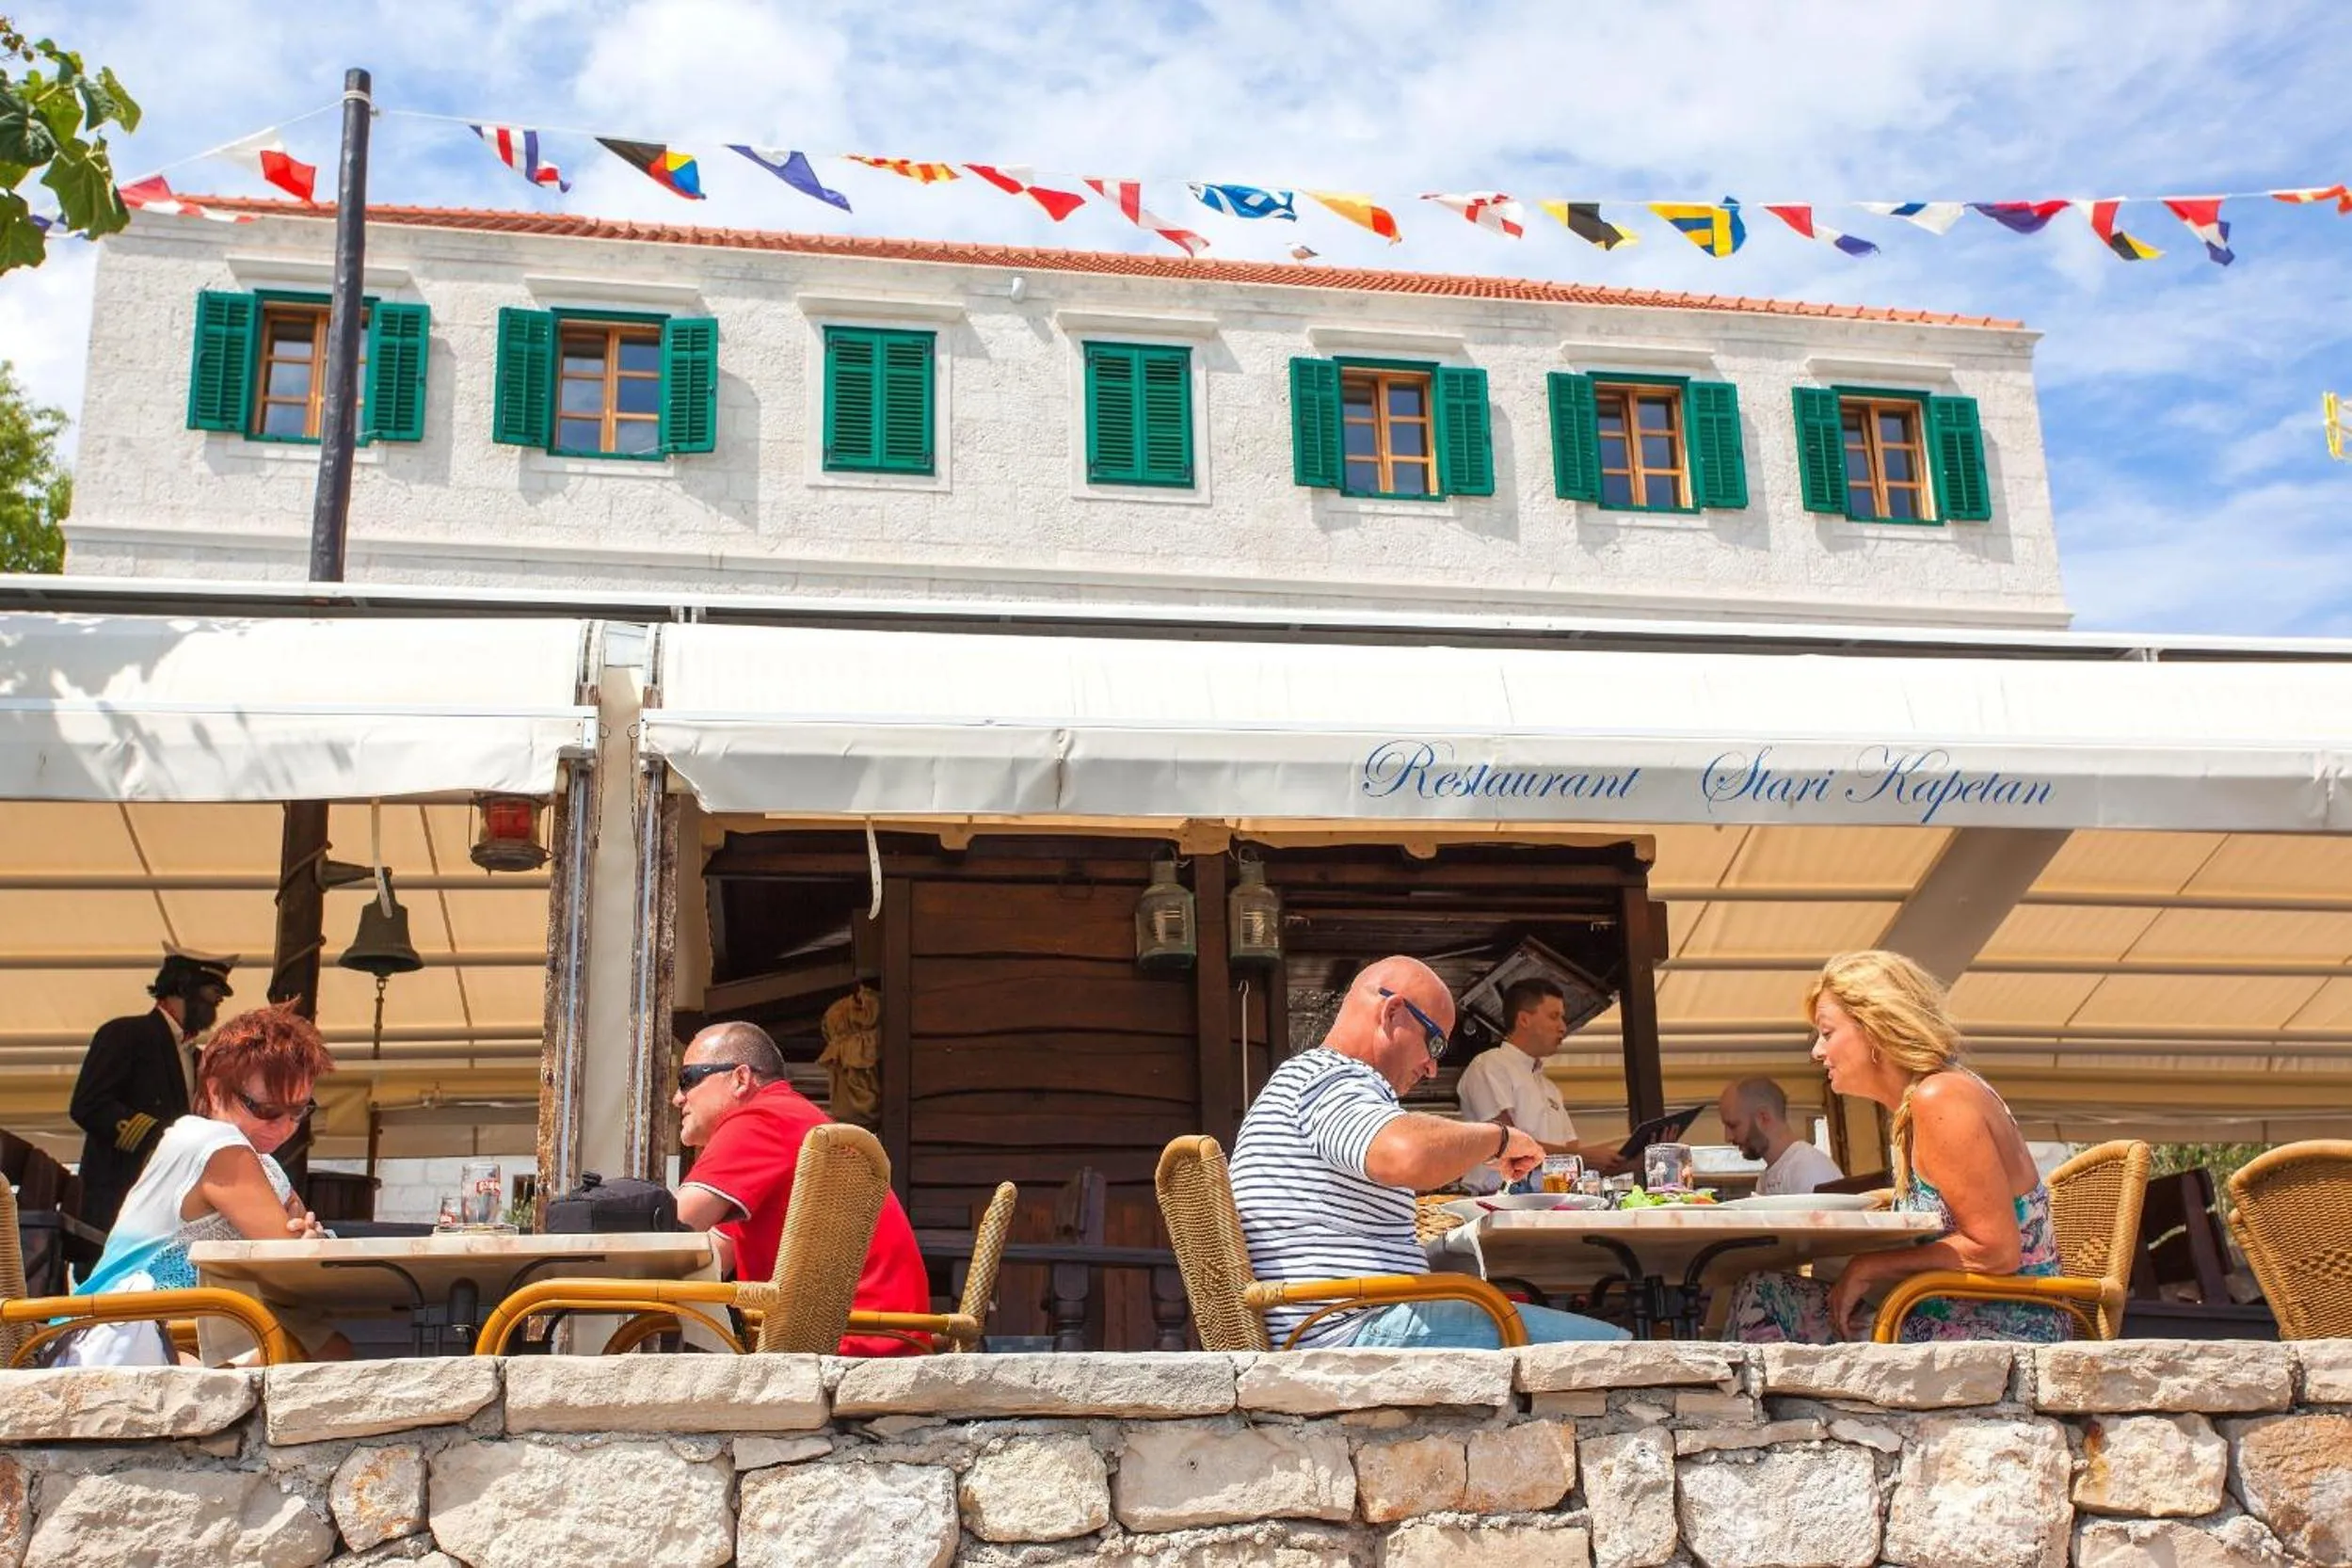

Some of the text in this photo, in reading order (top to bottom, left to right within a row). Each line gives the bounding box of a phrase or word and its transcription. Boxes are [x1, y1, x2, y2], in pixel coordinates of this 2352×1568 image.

[1364, 740, 2053, 824] Restaurant Stari Kapetan
